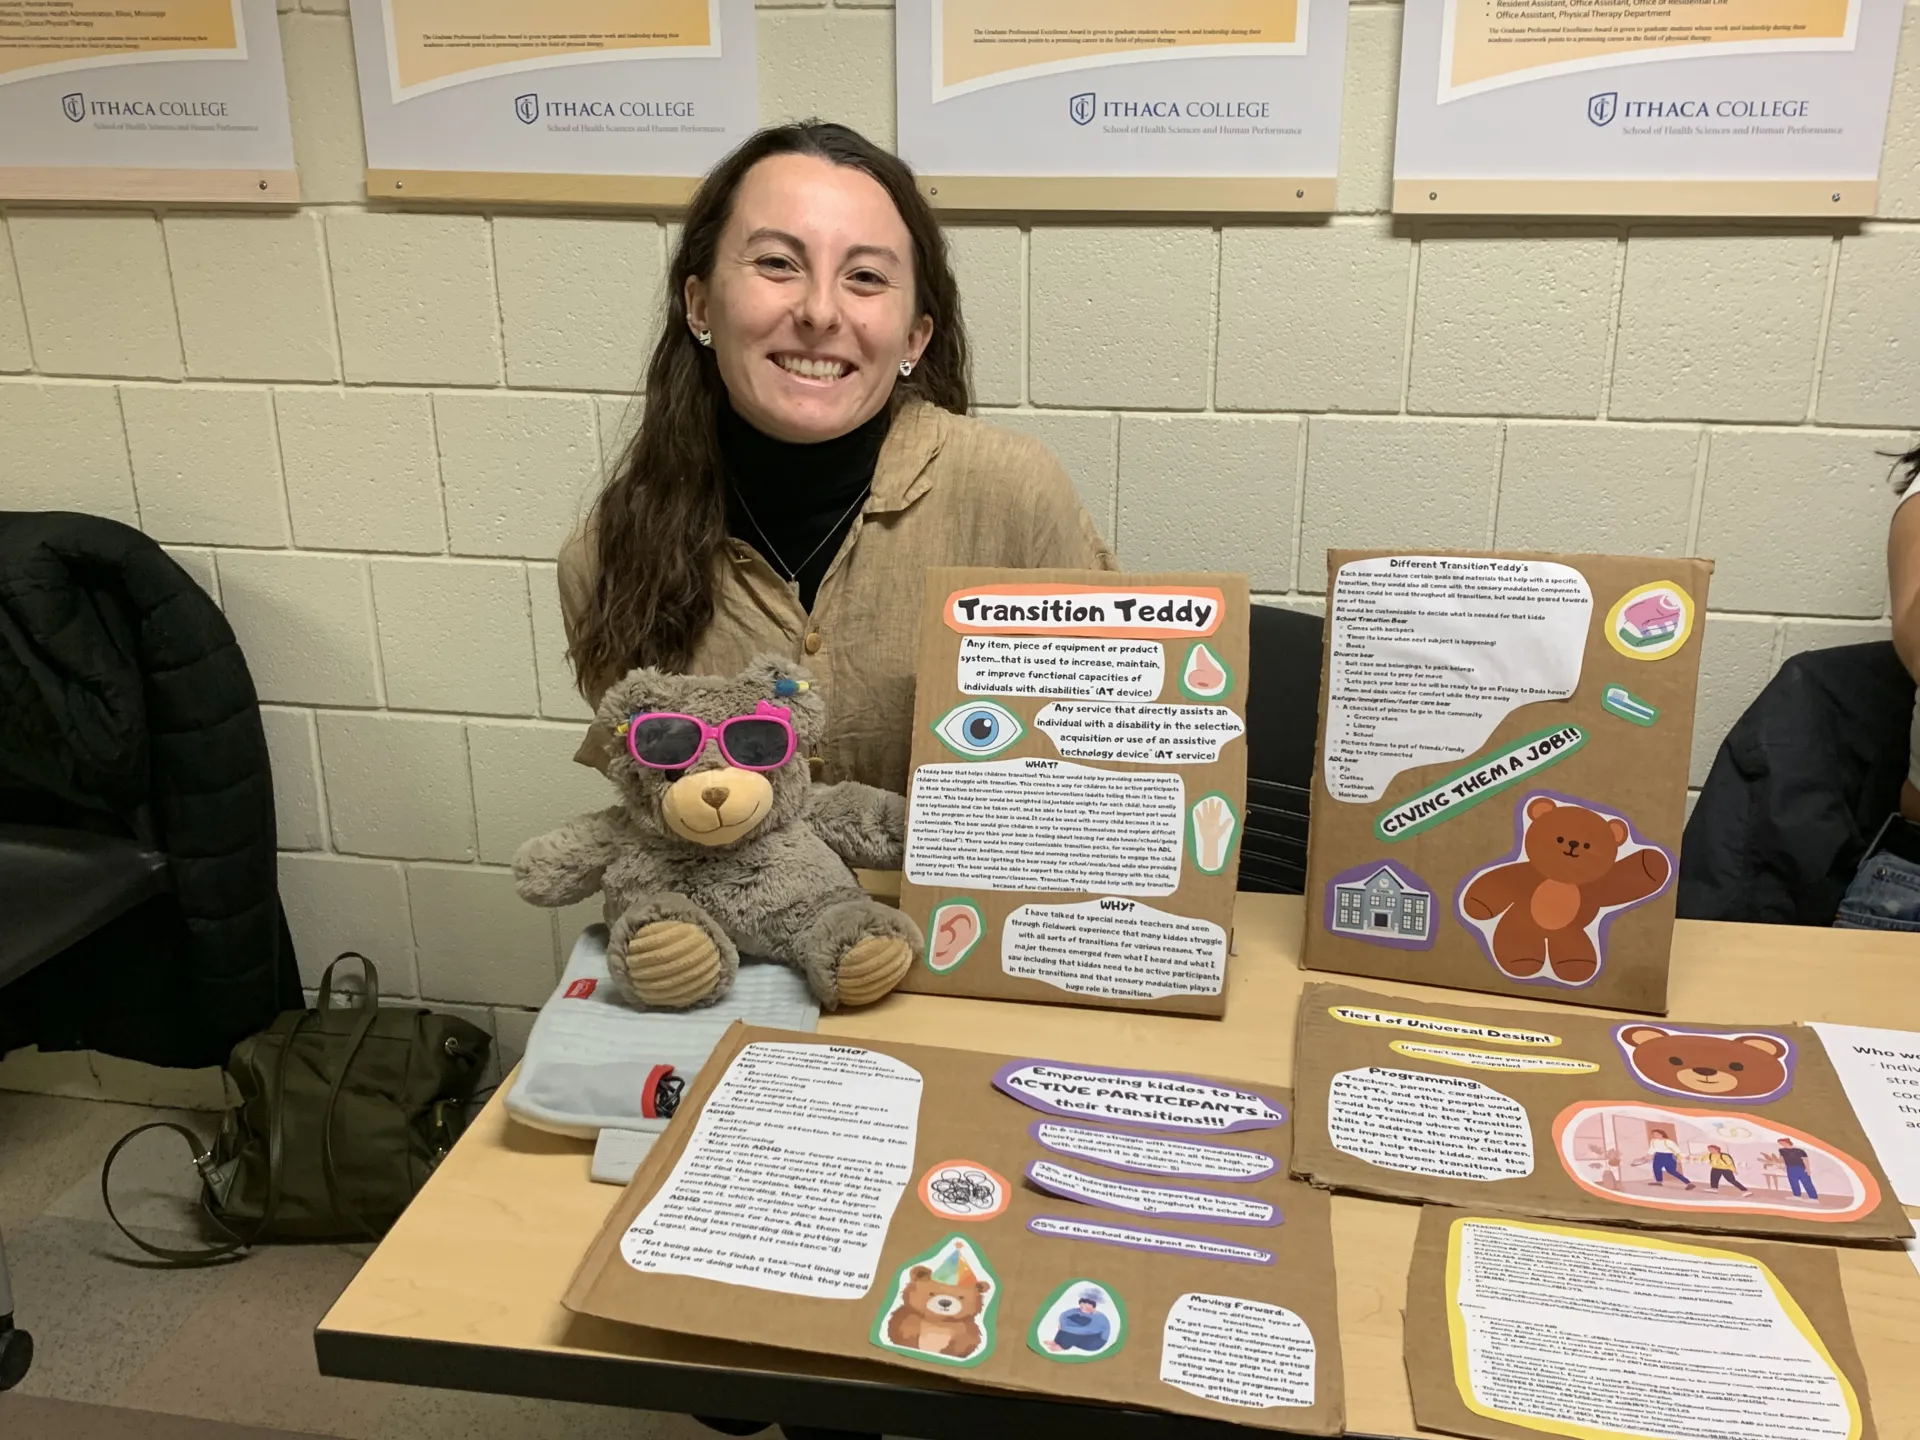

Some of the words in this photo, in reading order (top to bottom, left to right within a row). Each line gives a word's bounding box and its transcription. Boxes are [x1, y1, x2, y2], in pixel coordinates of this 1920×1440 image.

[1496, 11, 1519, 19] Office
[1558, 10, 1590, 20] Physical
[1592, 10, 1623, 19] Therapy
[1624, 9, 1671, 18] Department
[91, 101, 156, 116] ITHACA
[160, 102, 228, 116] COLLEGE
[546, 102, 615, 116] ITHACA
[620, 102, 694, 117] COLLEGE
[1104, 102, 1180, 117] ITHACA
[1186, 102, 1268, 117] COLLEGE
[1624, 102, 1709, 117] ITHACA
[1716, 101, 1809, 117] COLLEGE
[547, 124, 571, 132] School
[571, 124, 580, 132] of
[580, 124, 605, 132] Health
[605, 124, 635, 132] Sciences
[636, 124, 650, 132] and
[651, 124, 679, 132] Human
[680, 124, 725, 132] Performance
[1103, 126, 1128, 134] School
[1130, 126, 1139, 134] of
[1140, 126, 1166, 134] Health
[1168, 126, 1200, 134] Sciences
[1202, 126, 1217, 134] and
[1220, 126, 1249, 134] Human
[1252, 126, 1302, 135] Performance
[1623, 126, 1651, 134] School
[1653, 126, 1662, 134] of
[1664, 126, 1692, 134] Health
[1696, 126, 1730, 134] Sciences
[1732, 126, 1749, 134] and
[1751, 126, 1784, 134] Human
[1787, 126, 1843, 134] Performance
[958, 598, 1105, 622] Transition
[1114, 598, 1212, 627] Teddy
[1014, 642, 1040, 651] piece
[1042, 642, 1053, 650] of
[1055, 644, 1105, 653] equipment
[1120, 645, 1158, 654] product
[1024, 656, 1031, 664] is
[1034, 657, 1056, 665] used
[1059, 657, 1069, 665] to
[988, 669, 1025, 679] improve
[1028, 670, 1076, 680] functional
[1078, 674, 1129, 682] capacities
[1131, 674, 1142, 682] of
[964, 682, 1013, 692] individuals
[1016, 685, 1036, 693] with
[1096, 687, 1114, 696] (AT
[1116, 688, 1152, 697] device)
[1076, 705, 1111, 713] service
[1114, 706, 1135, 714] that
[1138, 706, 1177, 716] directly
[1180, 707, 1214, 715] assists
[1037, 718, 1082, 728] individual
[1084, 720, 1106, 728] with
[1116, 720, 1161, 731] disability
[1175, 722, 1191, 730] the
[1060, 734, 1112, 743] acquisition
[1146, 736, 1156, 744] of
[1172, 737, 1216, 745] assistive
[1060, 749, 1114, 758] technology
[1154, 750, 1173, 759] (AT
[1176, 751, 1215, 760] service)
[1025, 760, 1058, 769] WHAT?
[1383, 792, 1450, 833] GIVING
[1452, 764, 1508, 798] THEM
[1509, 756, 1524, 770] A
[1527, 728, 1581, 761] JOB!!
[1100, 900, 1135, 912] WHY?
[1030, 909, 1048, 917] have
[1050, 911, 1075, 920] talked
[1140, 920, 1173, 929] teachers
[1011, 919, 1040, 929] through
[1042, 922, 1076, 931] fieldwork
[1078, 927, 1120, 935] experience
[1141, 933, 1161, 941] many
[1163, 934, 1188, 942] kiddos
[1190, 936, 1222, 946] struggle
[1066, 983, 1084, 992] huge
[1337, 1009, 1371, 1020] Tier
[1407, 1020, 1483, 1036] Universal
[1852, 1046, 1894, 1056] Who
[1033, 1066, 1142, 1088] Empowering
[1148, 1081, 1205, 1094] kiddos
[1212, 1089, 1232, 1097] to
[1236, 1092, 1258, 1101] be
[1010, 1076, 1091, 1096] ACTIVE
[1097, 1089, 1258, 1115] PARTICIPANTS
[1263, 1110, 1280, 1120] in
[1054, 1098, 1099, 1110] their
[1104, 1104, 1225, 1127] transitions!!!
[1898, 1105, 1920, 1113] th
[1073, 1226, 1088, 1234] the
[1091, 1230, 1121, 1240] school
[1124, 1234, 1142, 1242] day
[1155, 1239, 1182, 1247] spent
[1199, 1243, 1252, 1256] transitions
[1190, 1295, 1232, 1308] Moving
